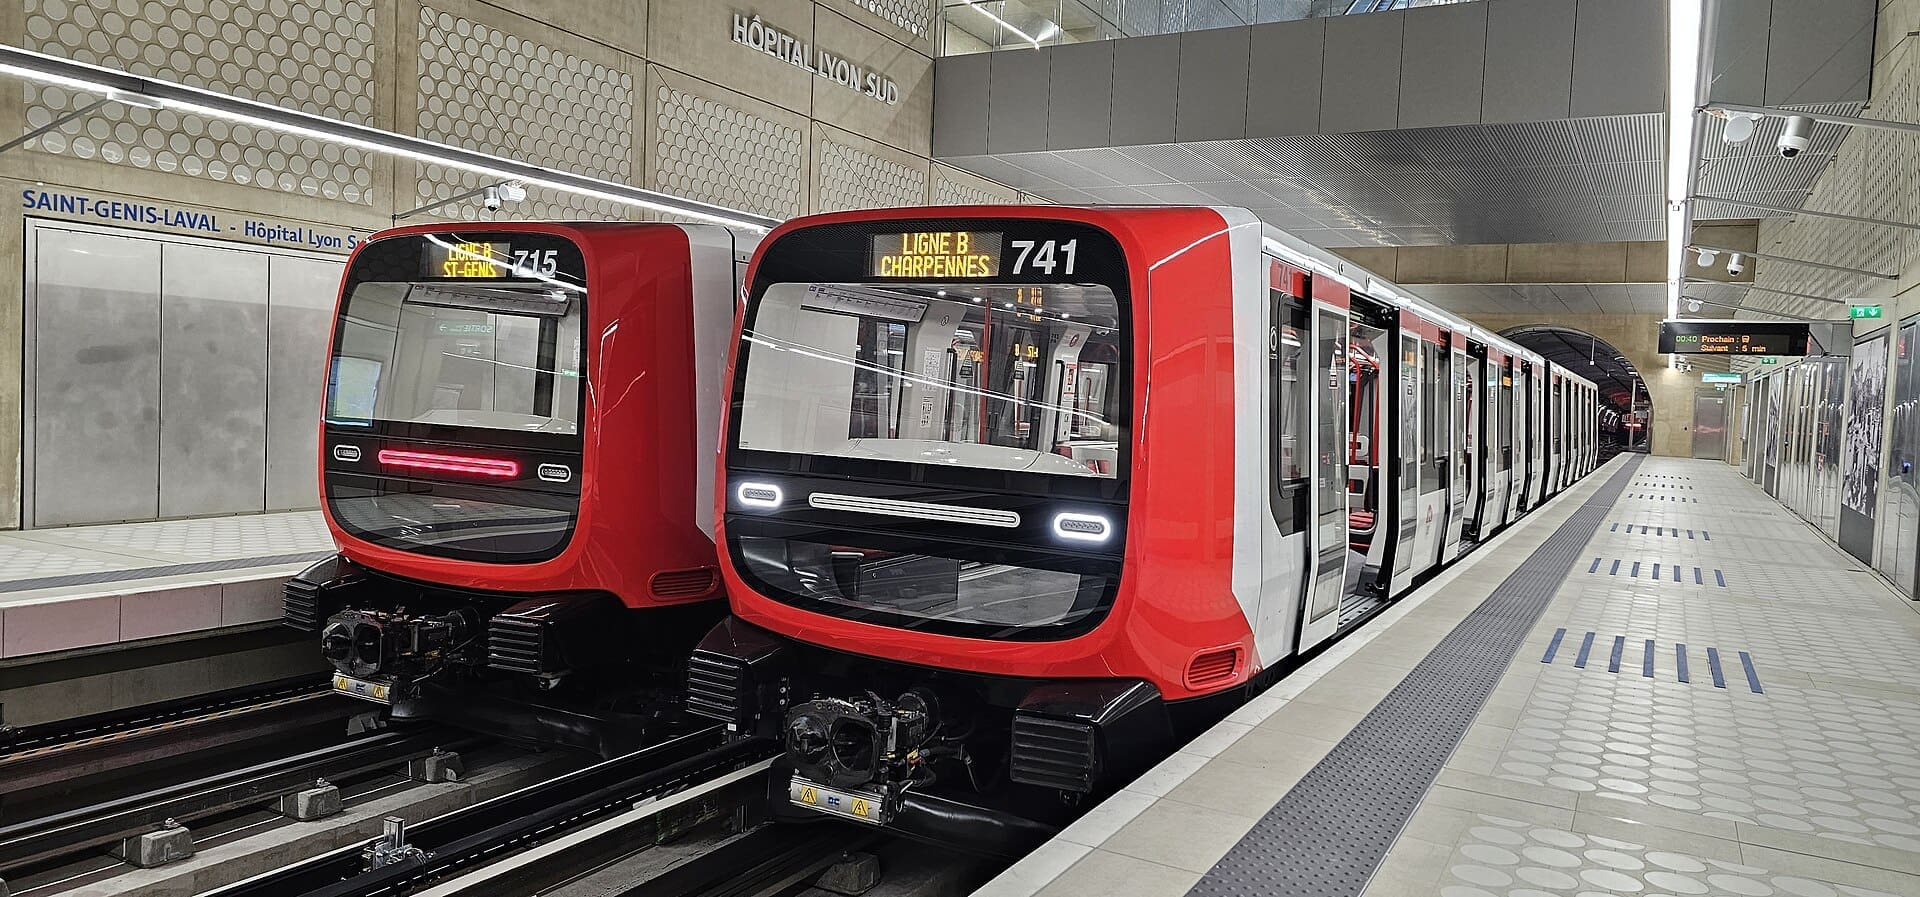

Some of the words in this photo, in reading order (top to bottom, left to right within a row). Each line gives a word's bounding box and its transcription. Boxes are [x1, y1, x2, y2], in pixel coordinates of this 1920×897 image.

[732, 14, 816, 73] HÔPITAL
[817, 50, 862, 92] LYON
[864, 72, 899, 106] SUD
[22, 189, 220, 232] SAINT-GENIS-LAVAL
[244, 220, 303, 244] Hôpital
[308, 233, 341, 250] Lyon
[448, 243, 478, 261] LIGNE
[483, 243, 492, 259] B
[902, 233, 951, 255] LIGNE
[957, 233, 968, 254] B
[514, 249, 558, 275] 715
[881, 255, 990, 277] CHARPENNES
[1011, 239, 1077, 275] 741
[443, 261, 496, 277] ST-GENIS
[1701, 335, 1735, 343] Prochain
